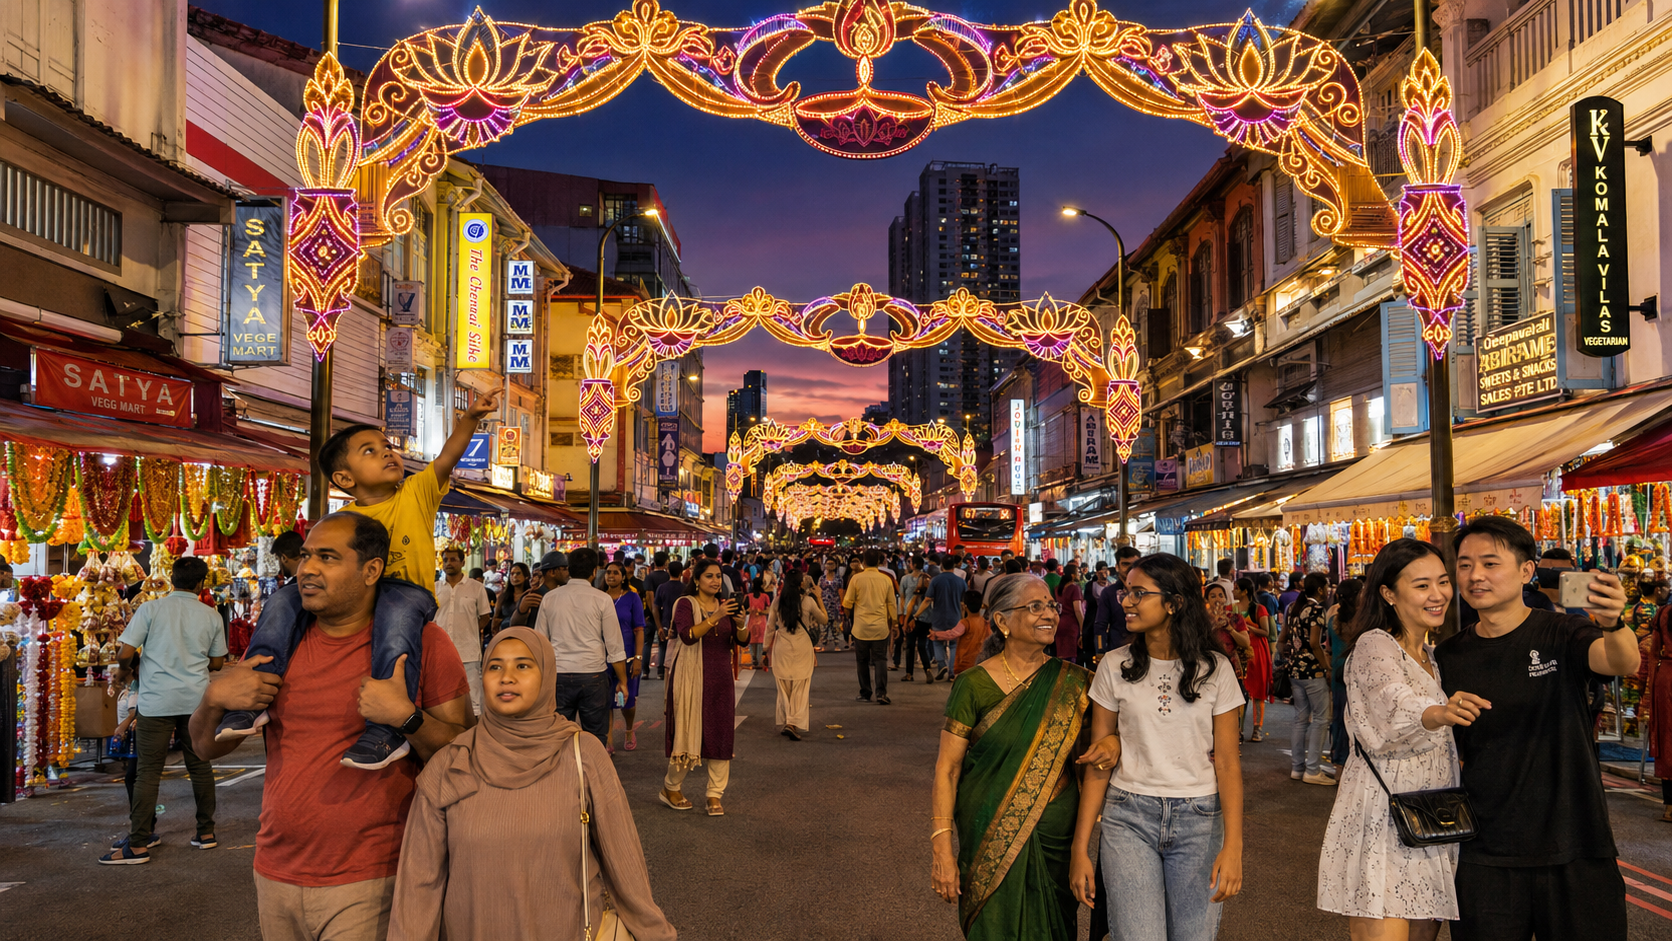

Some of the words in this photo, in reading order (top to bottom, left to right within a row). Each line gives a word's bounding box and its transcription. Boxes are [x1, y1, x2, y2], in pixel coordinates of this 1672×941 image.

[1595, 166, 1610, 258] KOMALA
[243, 218, 267, 325] SATYA
[470, 248, 483, 271] The
[1597, 263, 1612, 333] VILAS
[232, 345, 277, 356] MART
[233, 332, 277, 343] VEGE
[1584, 336, 1628, 346] VEGETARIAN
[63, 363, 173, 406] SATYA
[1480, 388, 1511, 405] SALES
[1537, 376, 1557, 393] LTD
[119, 401, 146, 415] MART
